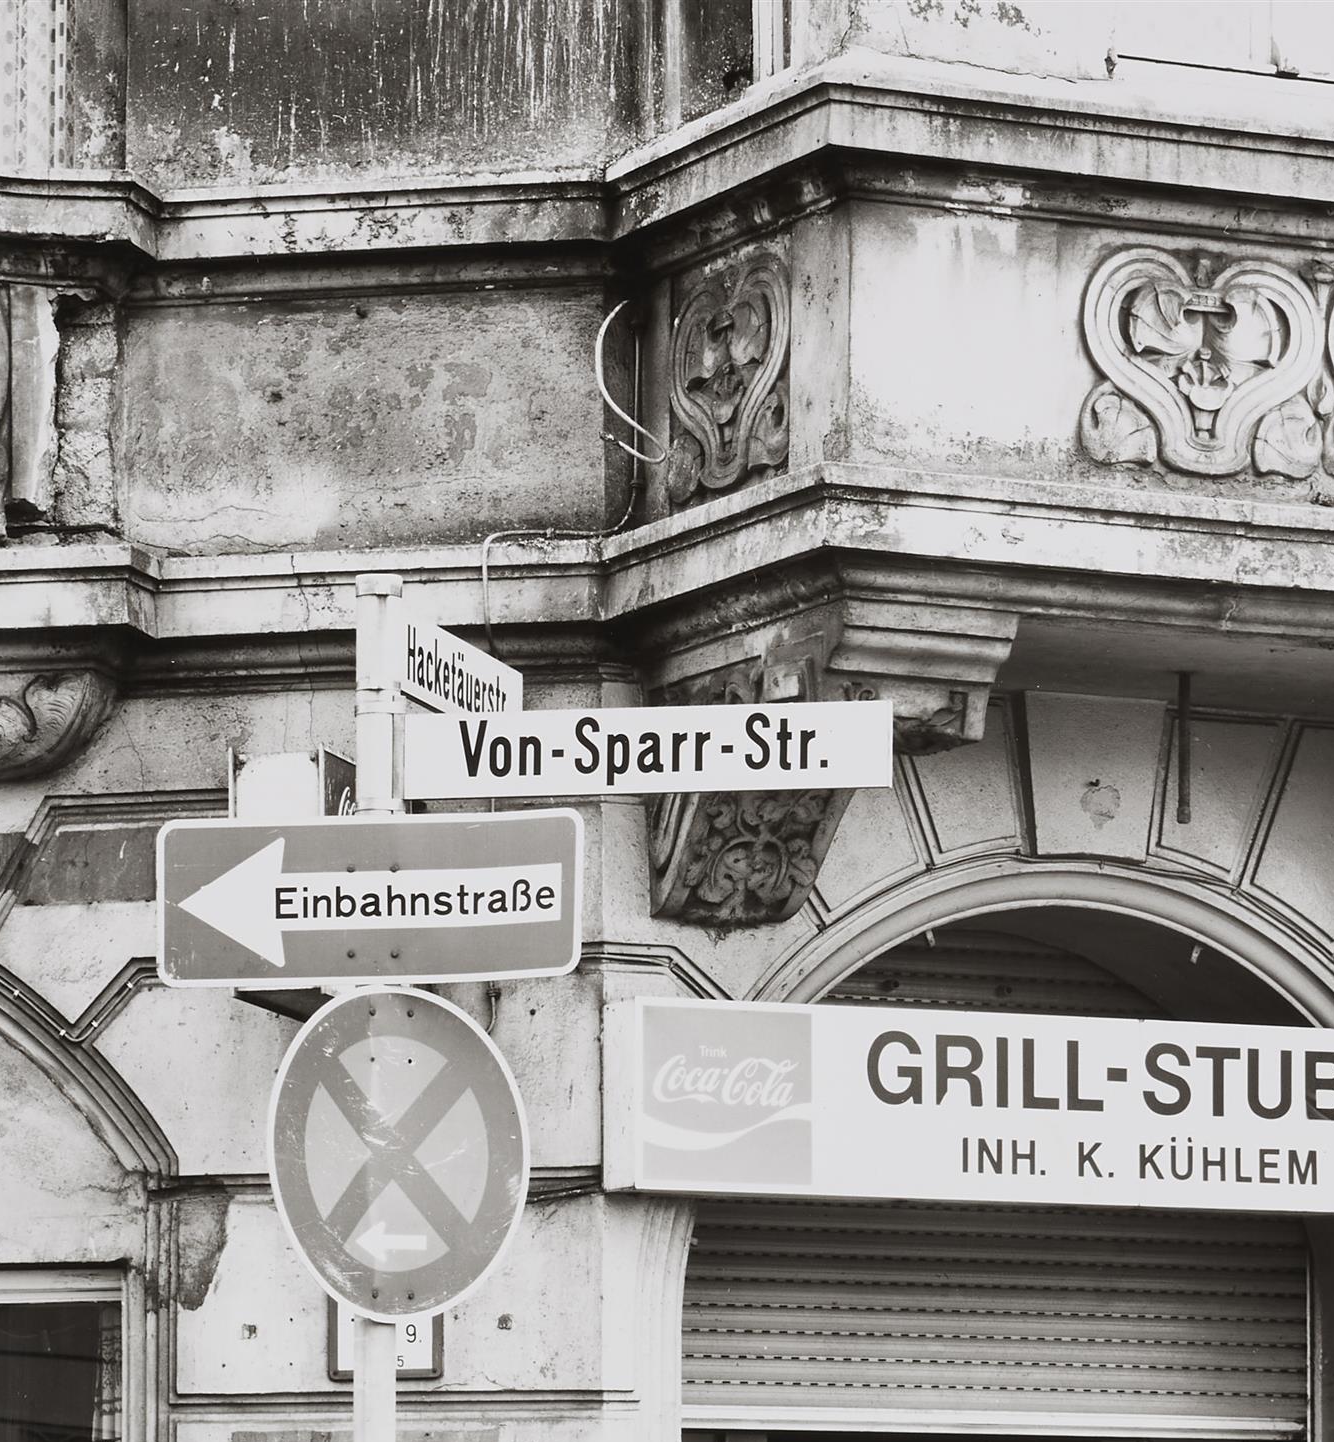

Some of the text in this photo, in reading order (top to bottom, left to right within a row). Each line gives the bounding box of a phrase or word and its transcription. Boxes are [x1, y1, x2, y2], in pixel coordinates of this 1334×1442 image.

[459, 713, 829, 786] Von-Sparr-Str.
[275, 878, 555, 919] Einbahnstraße
[698, 1044, 728, 1058] Trink
[652, 1054, 799, 1107] Coca-Cola
[962, 1136, 1318, 1185] INH. K. KÜHLEM
